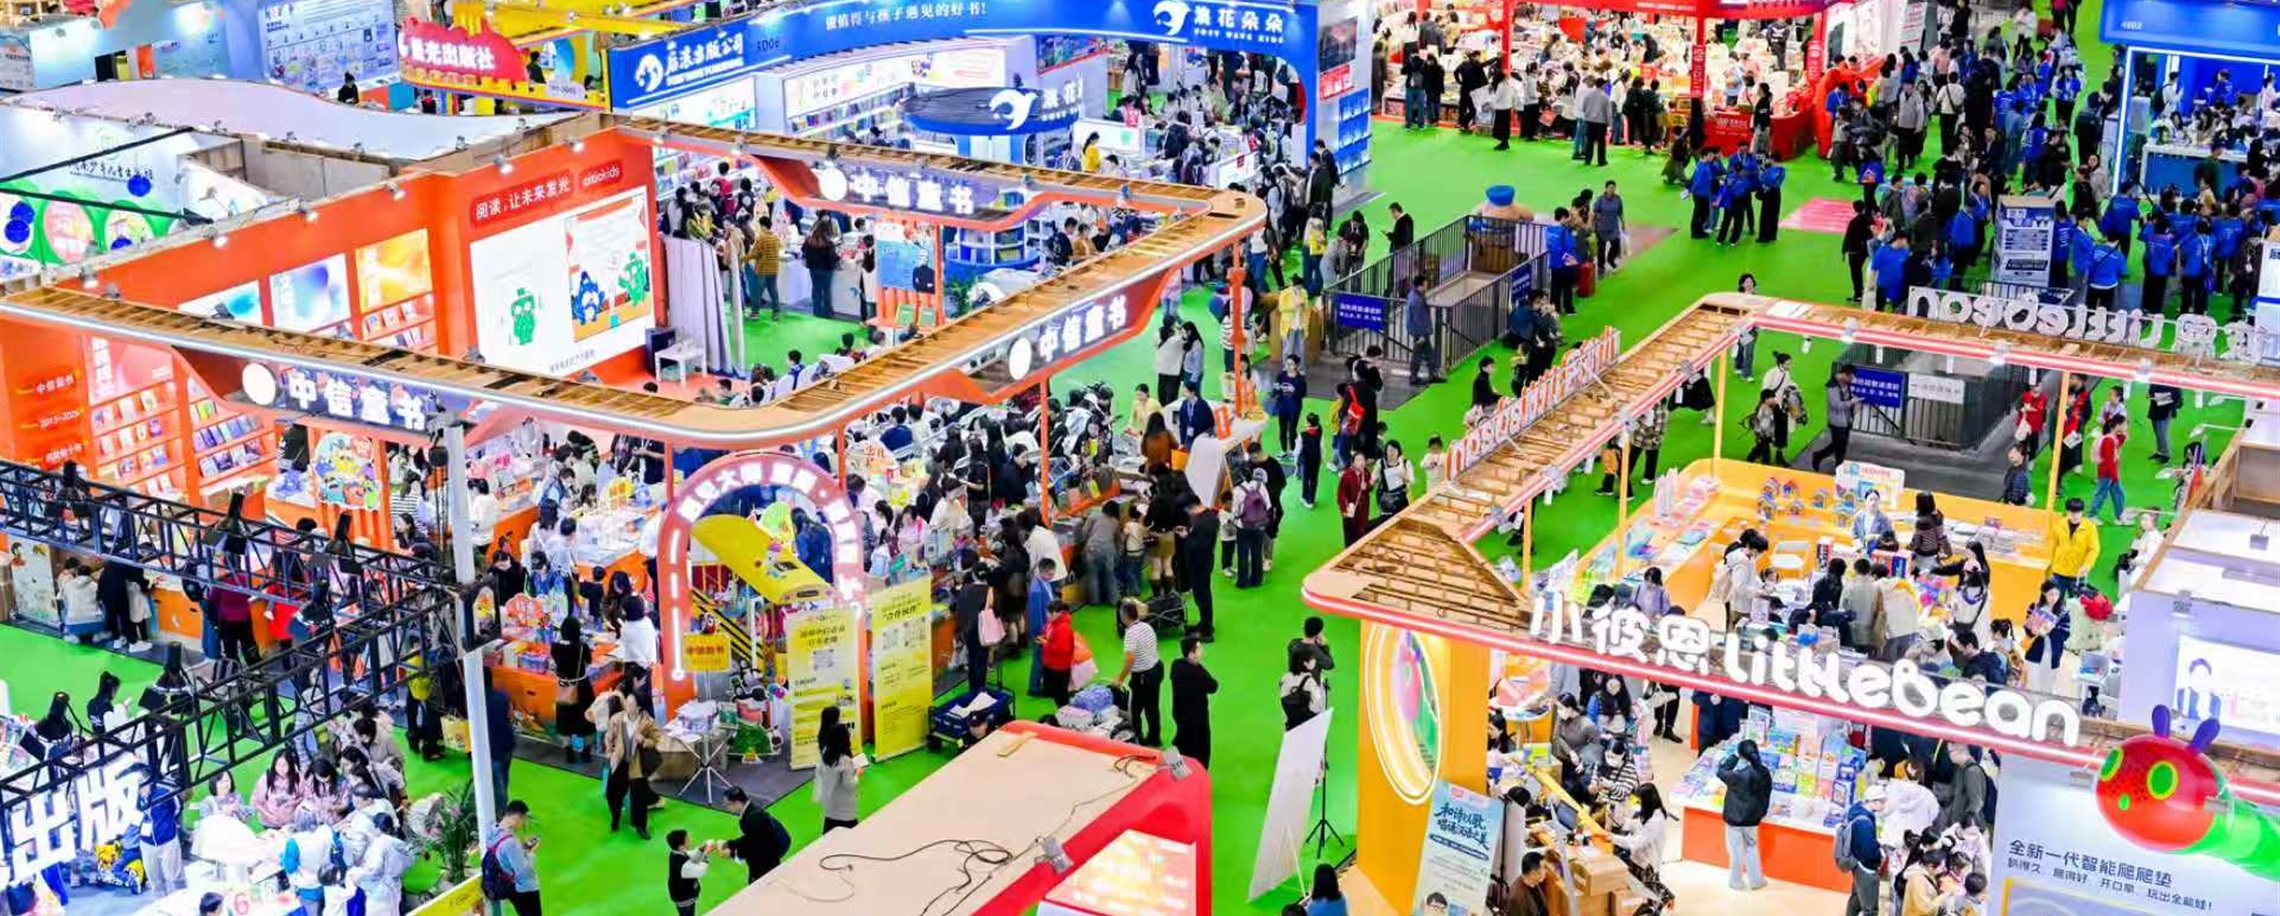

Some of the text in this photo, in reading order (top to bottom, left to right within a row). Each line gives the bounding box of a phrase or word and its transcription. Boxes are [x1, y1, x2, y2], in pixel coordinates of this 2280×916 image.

[288, 370, 427, 431] 中信童书
[1530, 591, 1710, 676] 小彼恩
[2009, 839, 2173, 889] 全新一代智能爬爬垫
